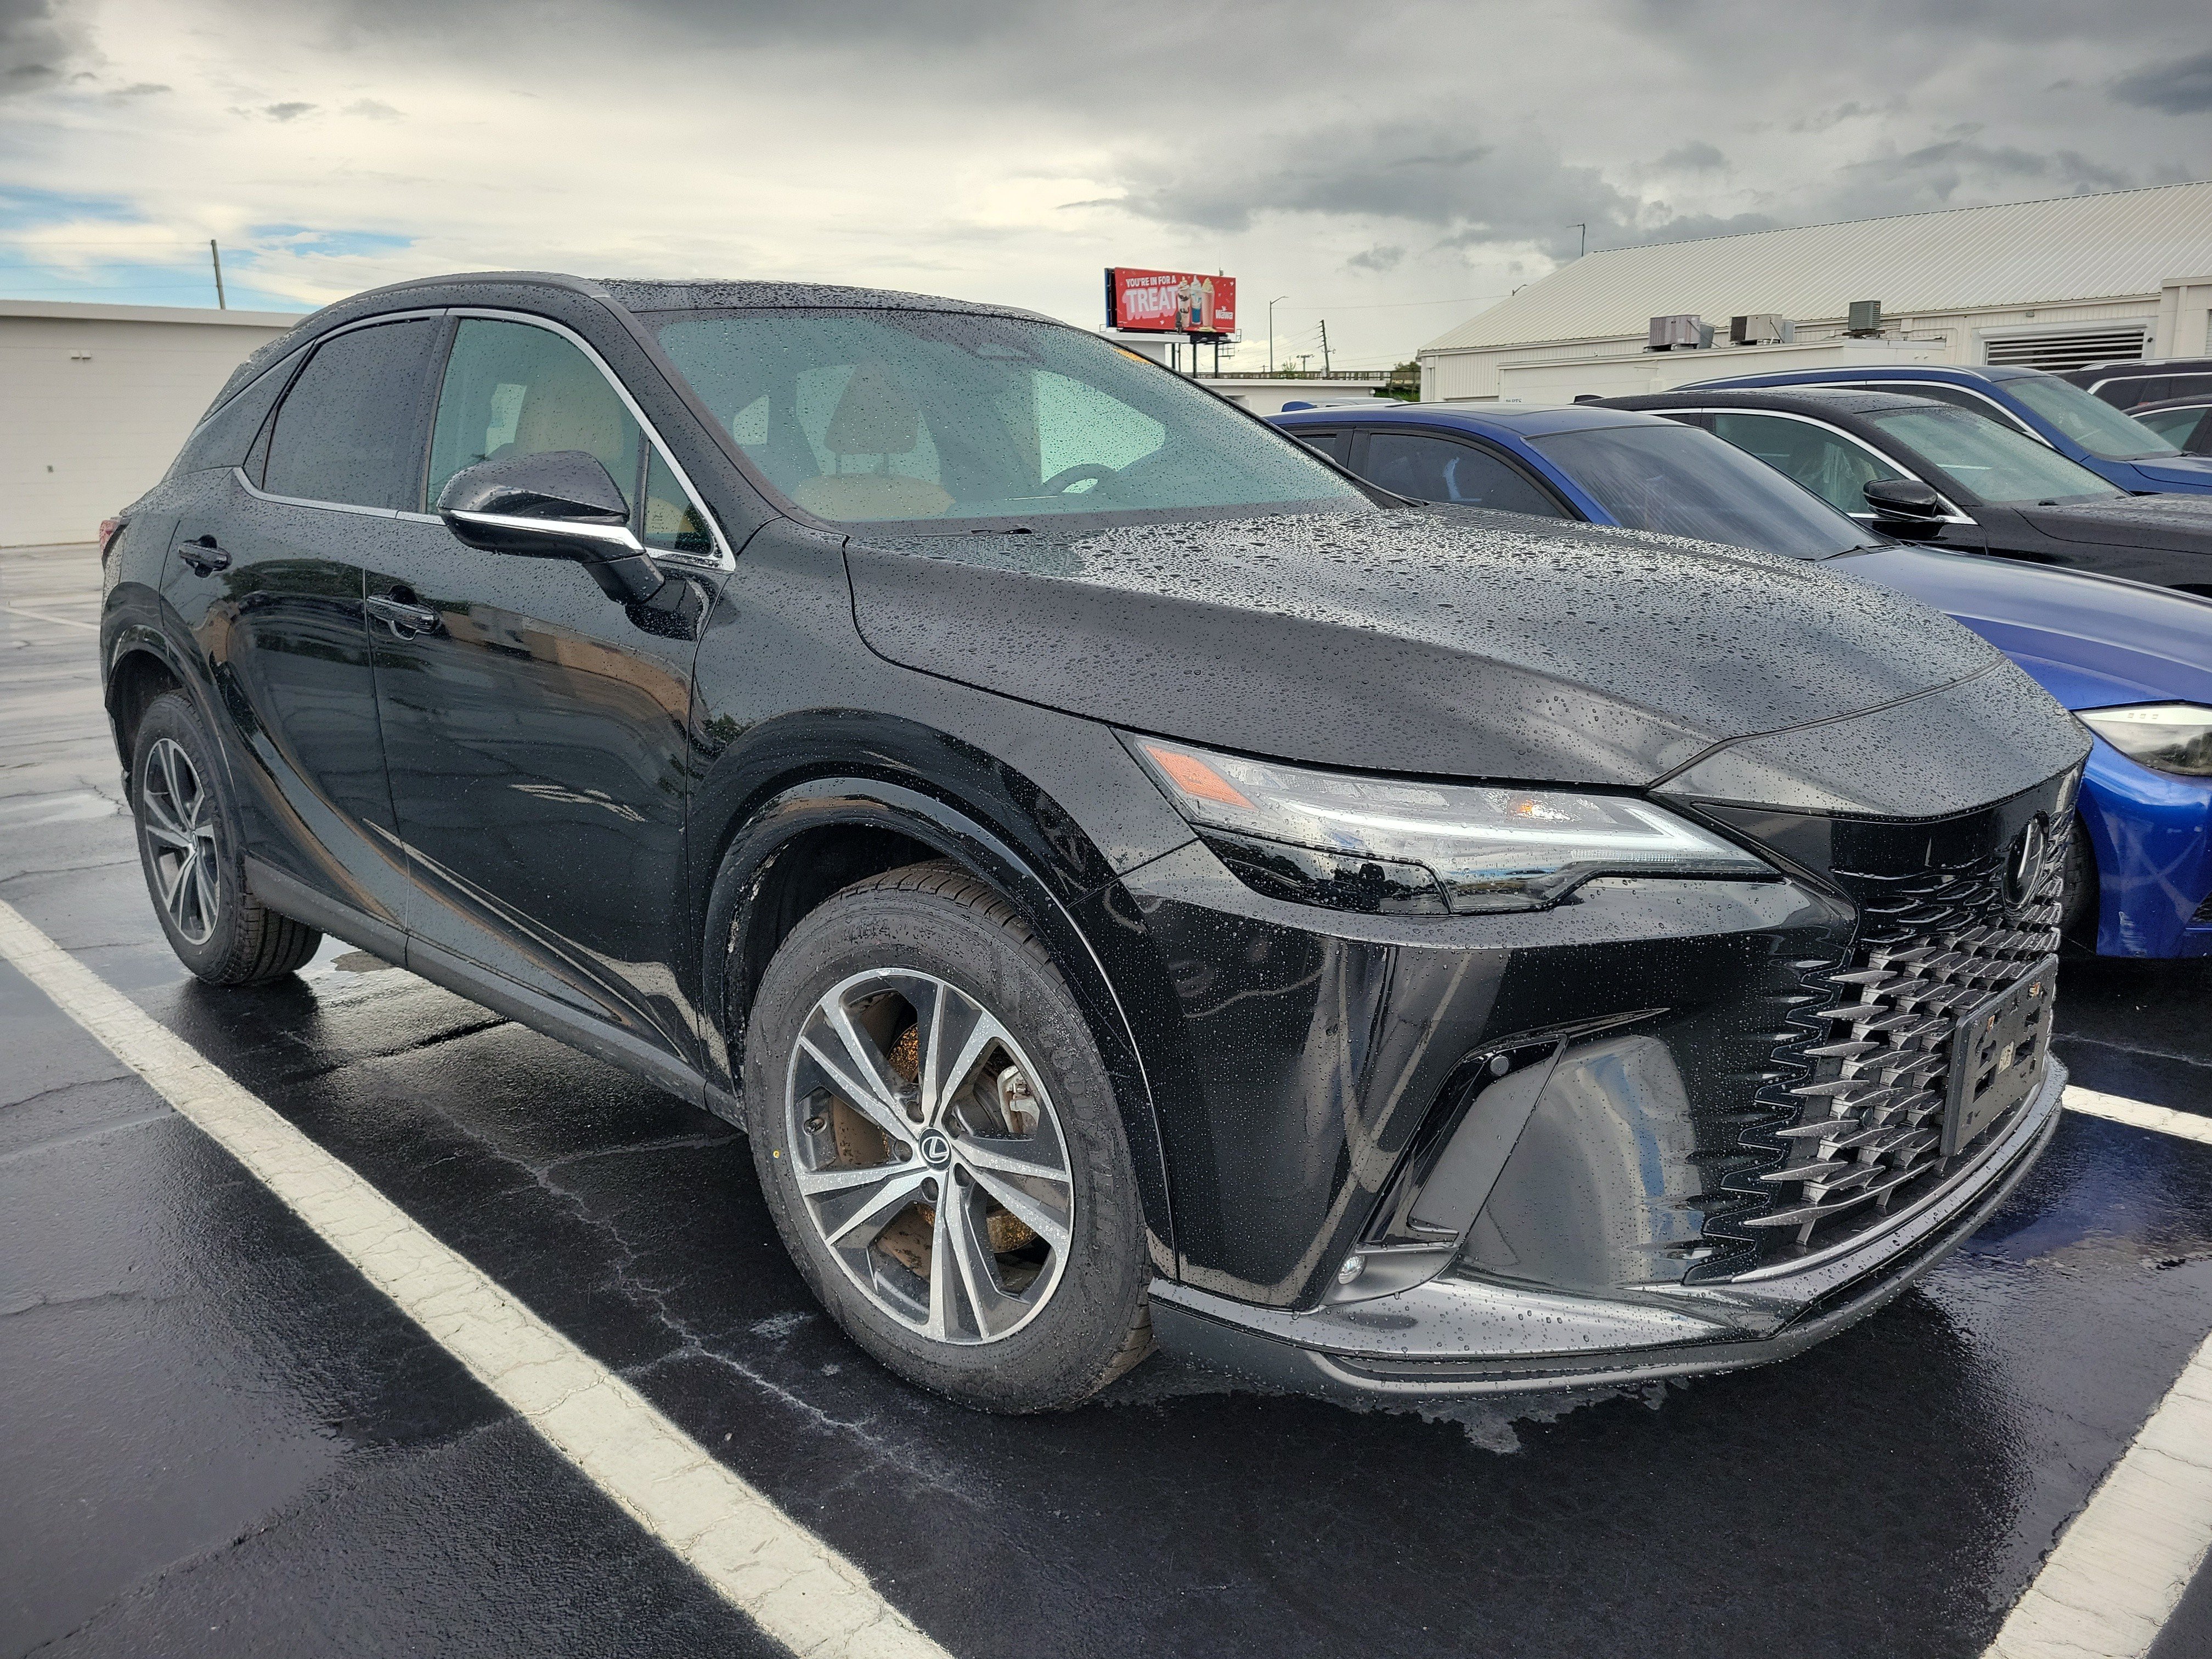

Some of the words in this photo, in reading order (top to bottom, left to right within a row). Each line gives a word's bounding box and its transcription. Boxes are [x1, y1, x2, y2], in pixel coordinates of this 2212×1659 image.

[1126, 277, 1149, 287] YOU'RE
[1150, 277, 1157, 285] IN
[1158, 276, 1170, 285] FOR
[1126, 286, 1178, 313] TREAT
[1215, 309, 1233, 320] Wawa
